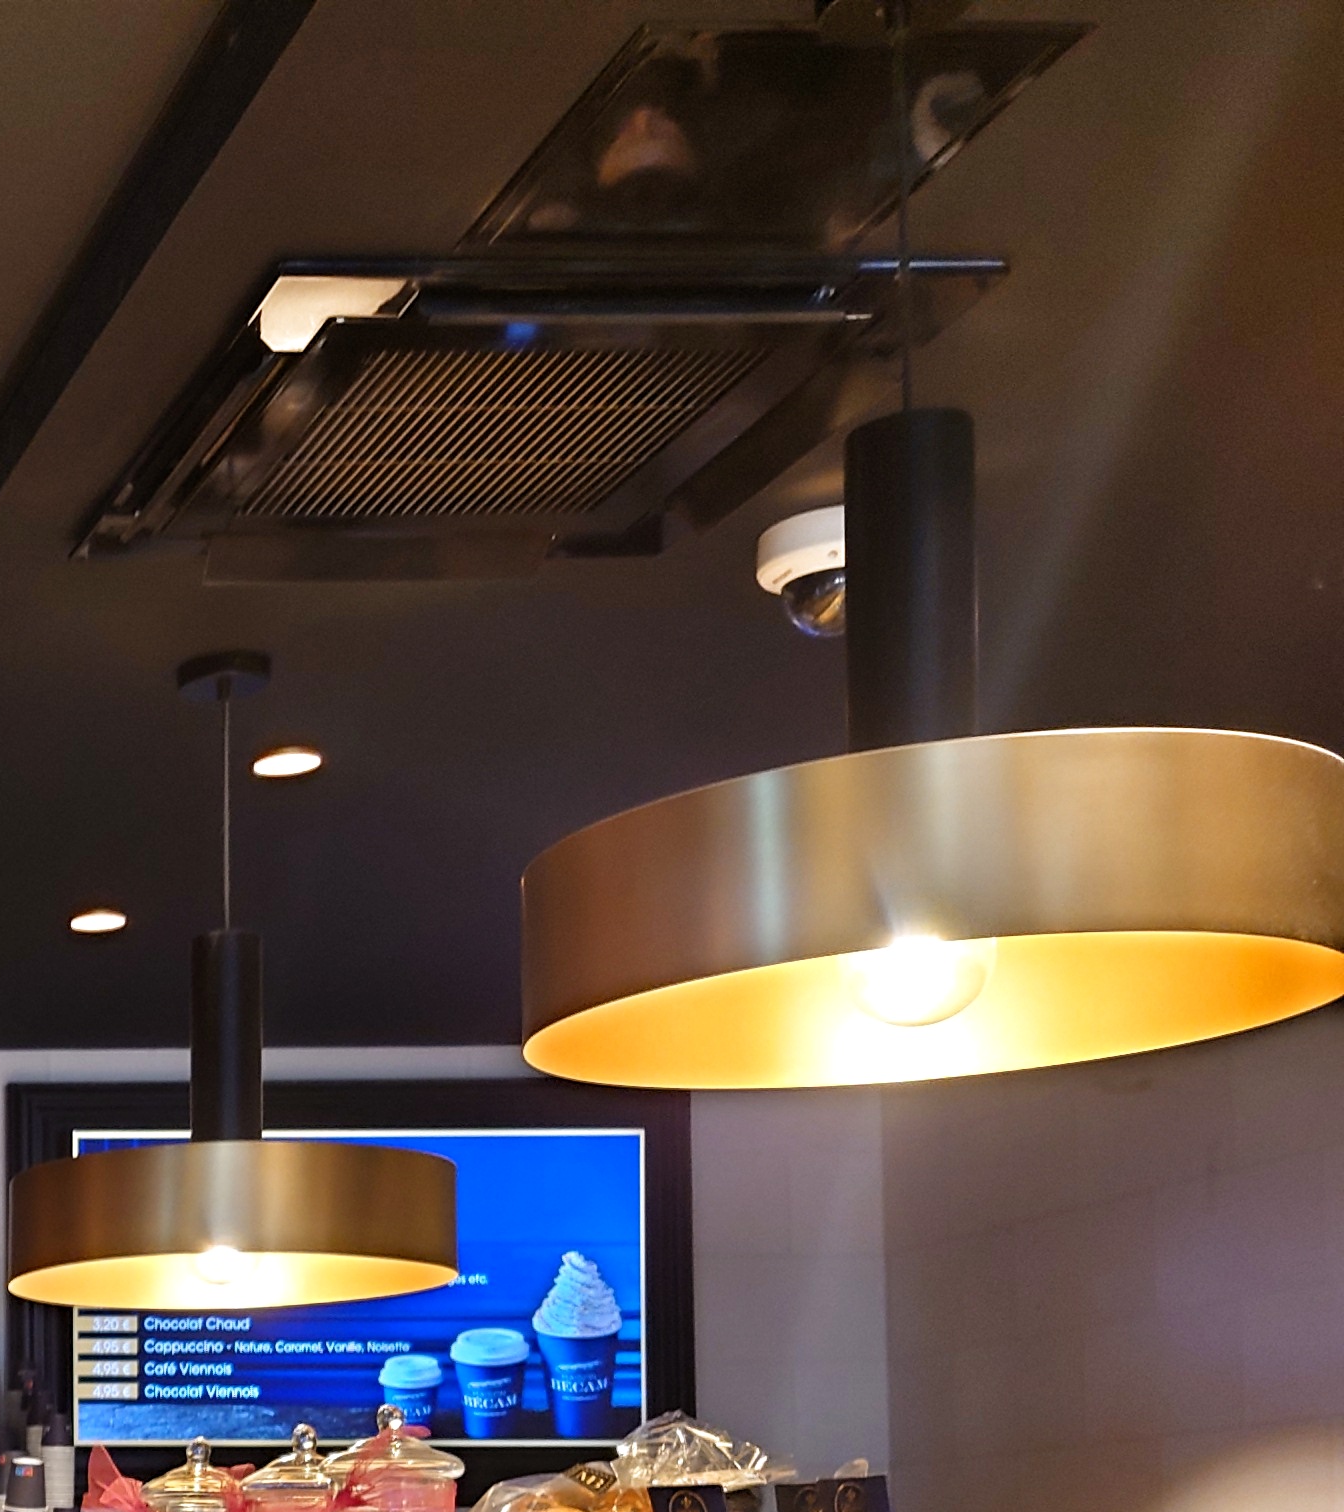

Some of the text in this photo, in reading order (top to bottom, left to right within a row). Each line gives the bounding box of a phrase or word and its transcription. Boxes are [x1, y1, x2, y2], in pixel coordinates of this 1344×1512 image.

[144, 1316, 251, 1332] Chocolat Chaud
[144, 1338, 224, 1356] Cappuccino
[144, 1360, 233, 1376] Café Viennois
[144, 1383, 260, 1399] Chocolat Viennois
